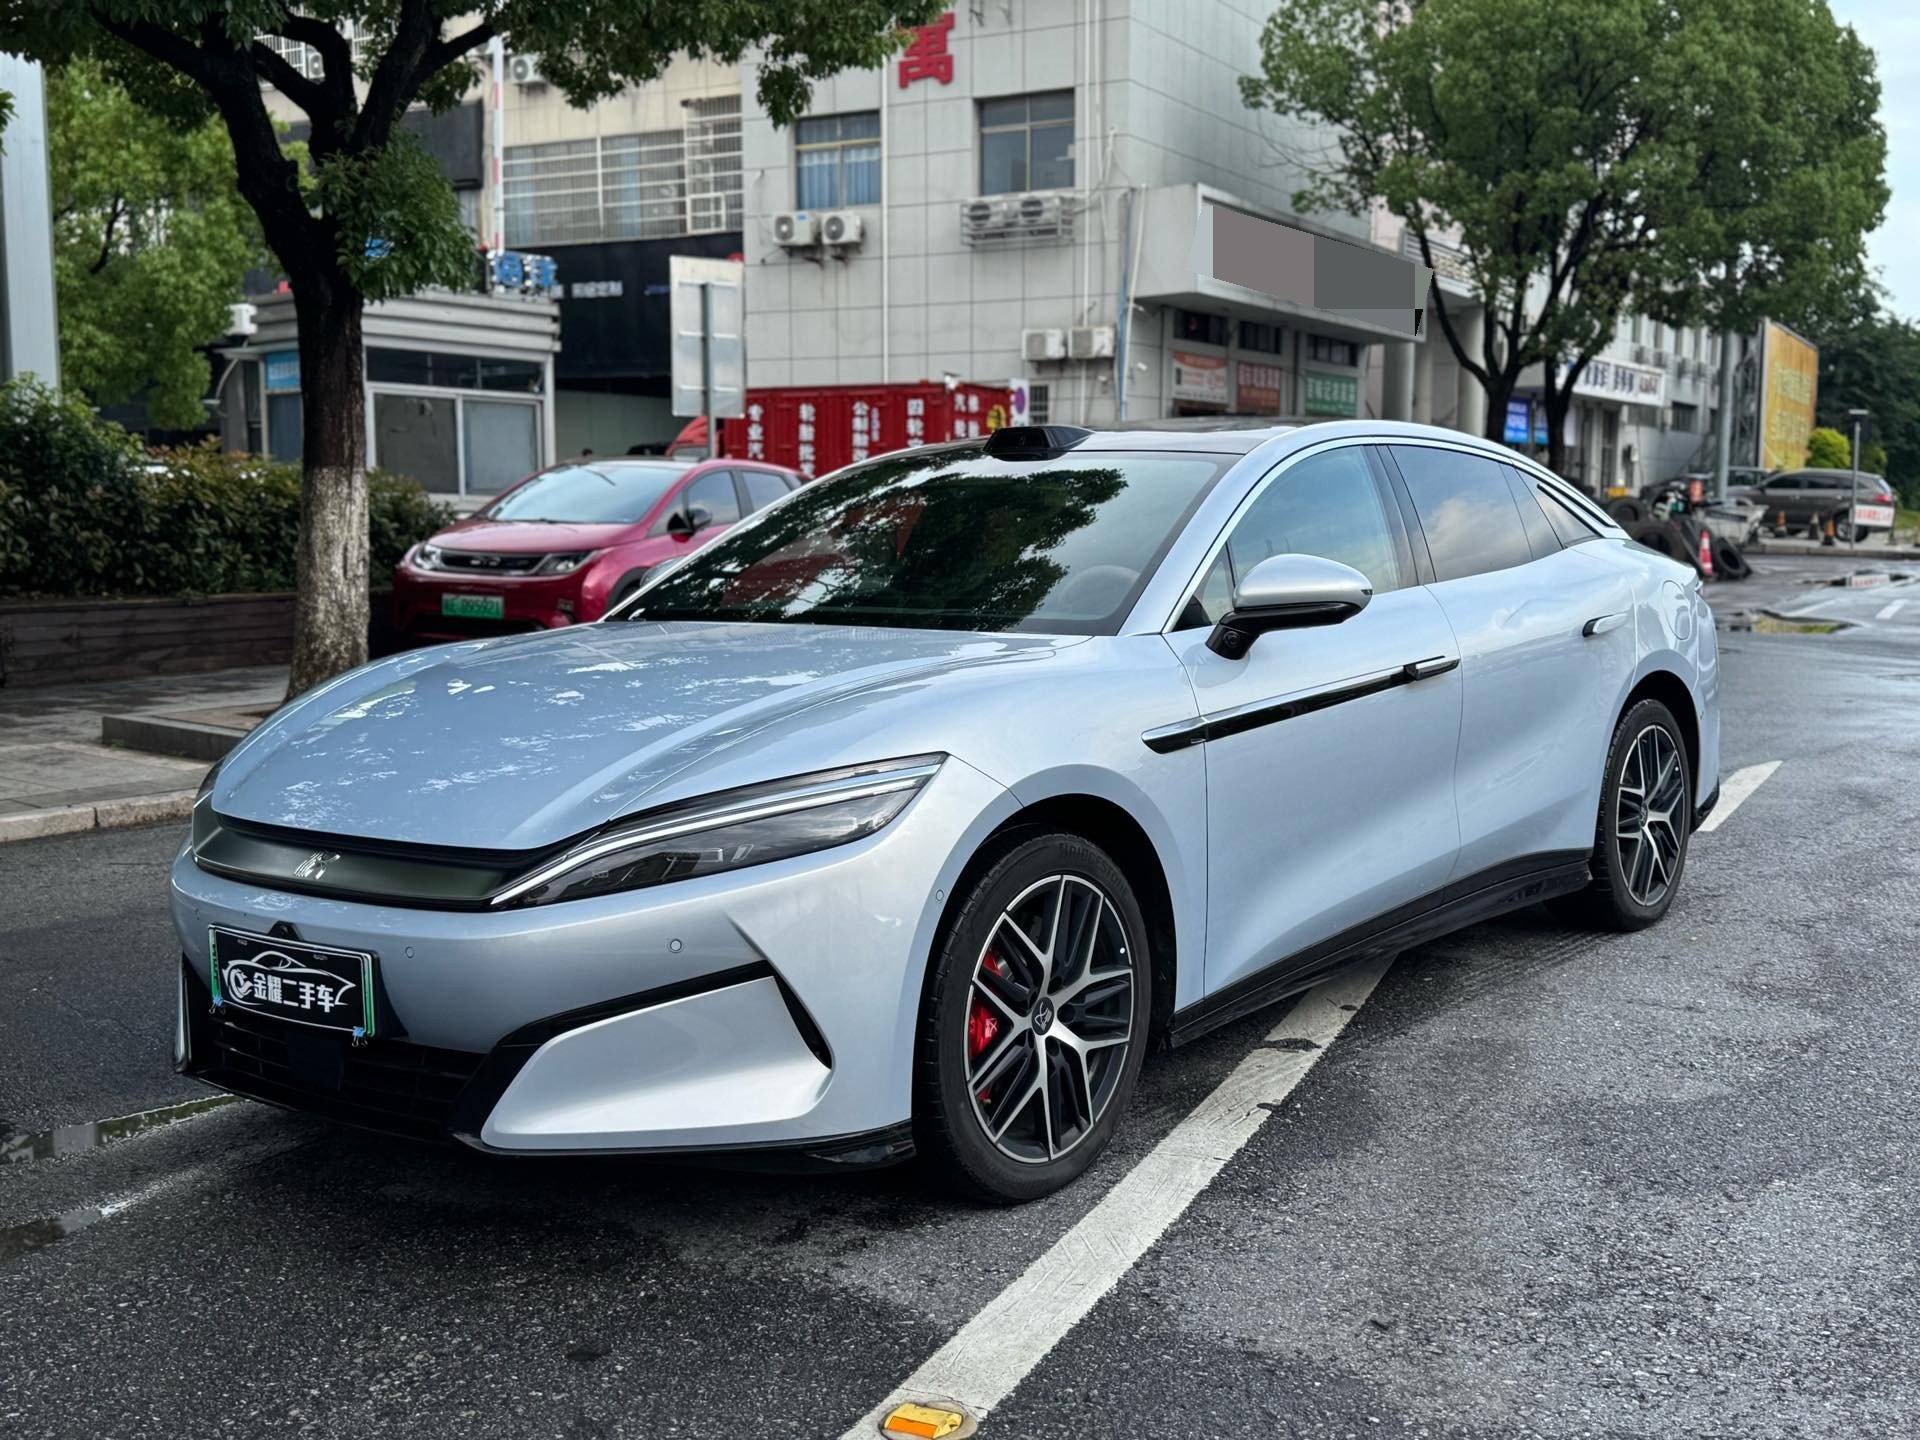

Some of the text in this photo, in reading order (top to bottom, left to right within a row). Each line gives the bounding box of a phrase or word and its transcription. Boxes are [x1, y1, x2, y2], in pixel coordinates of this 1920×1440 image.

[253, 971, 336, 1013] 金耀二手车
